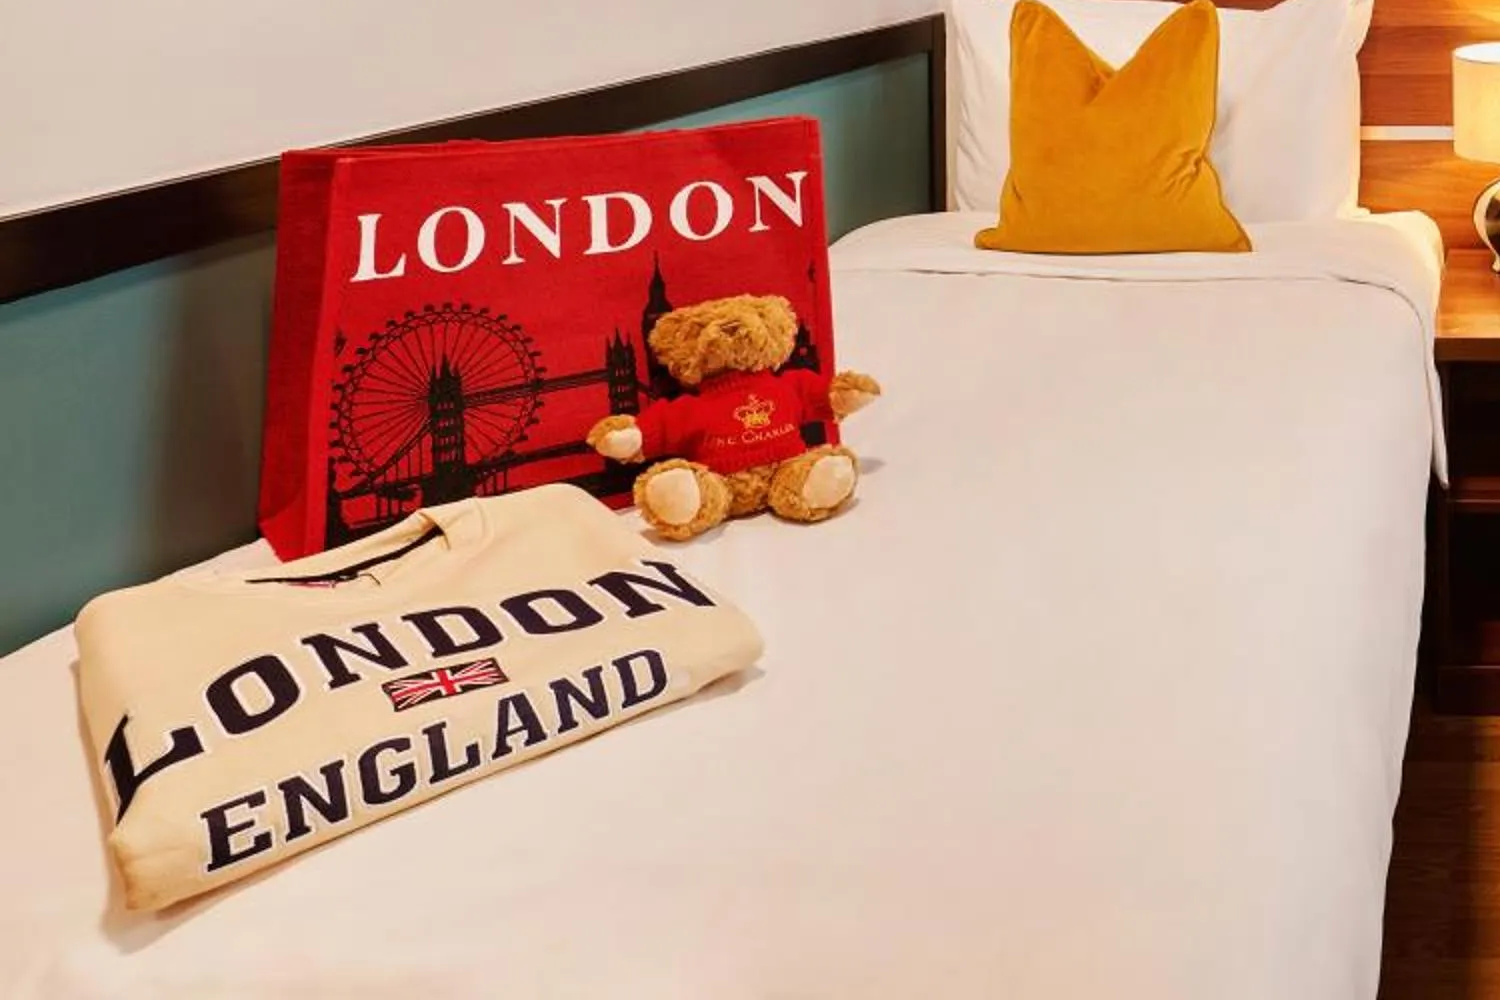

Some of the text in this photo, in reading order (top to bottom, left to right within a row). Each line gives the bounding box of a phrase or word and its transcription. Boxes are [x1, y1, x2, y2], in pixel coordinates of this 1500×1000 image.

[350, 171, 808, 283] LONDON
[104, 559, 717, 826] LONDON
[200, 649, 668, 872] ENGLAND
